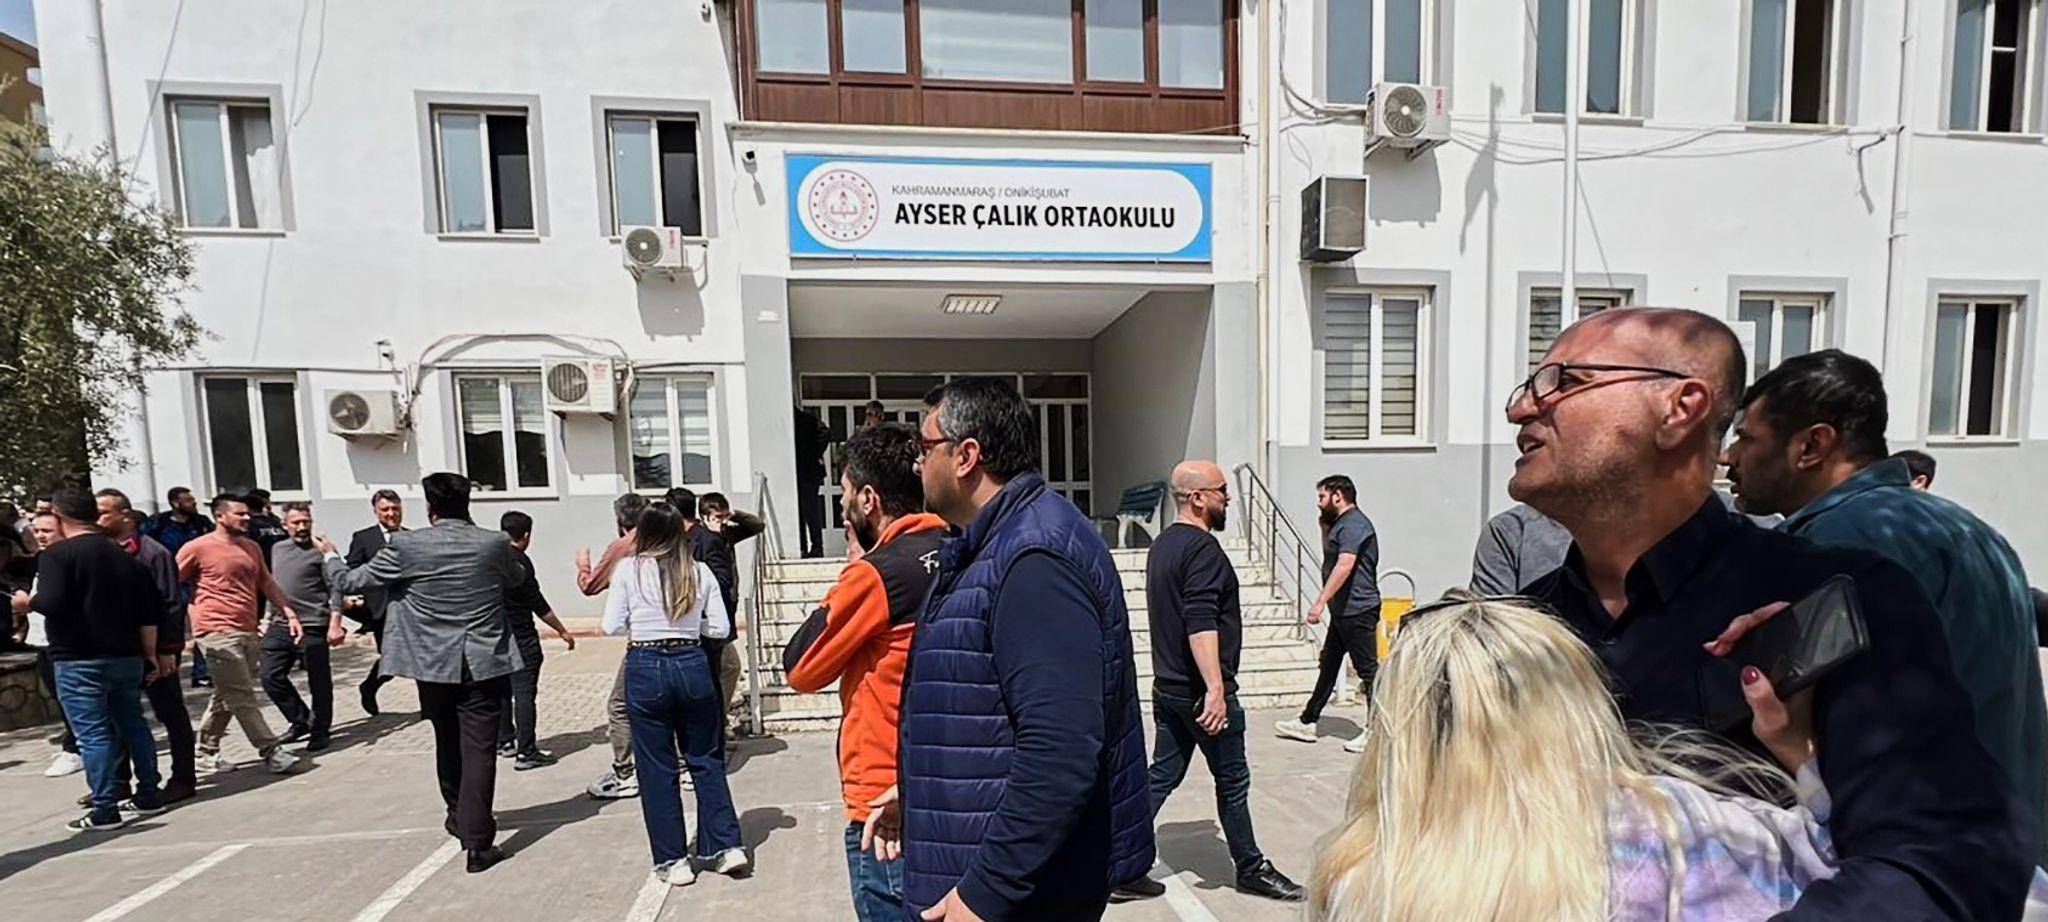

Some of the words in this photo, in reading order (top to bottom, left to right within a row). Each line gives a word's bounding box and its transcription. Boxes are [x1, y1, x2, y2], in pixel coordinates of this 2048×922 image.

[892, 185, 996, 199] KAHRAMANMARAŞ
[1004, 186, 1070, 200] ONİKİŞUBAT
[895, 203, 966, 225] AYSER
[973, 204, 1038, 230] ÇALIK
[1044, 205, 1175, 228] ORTAOKULU
